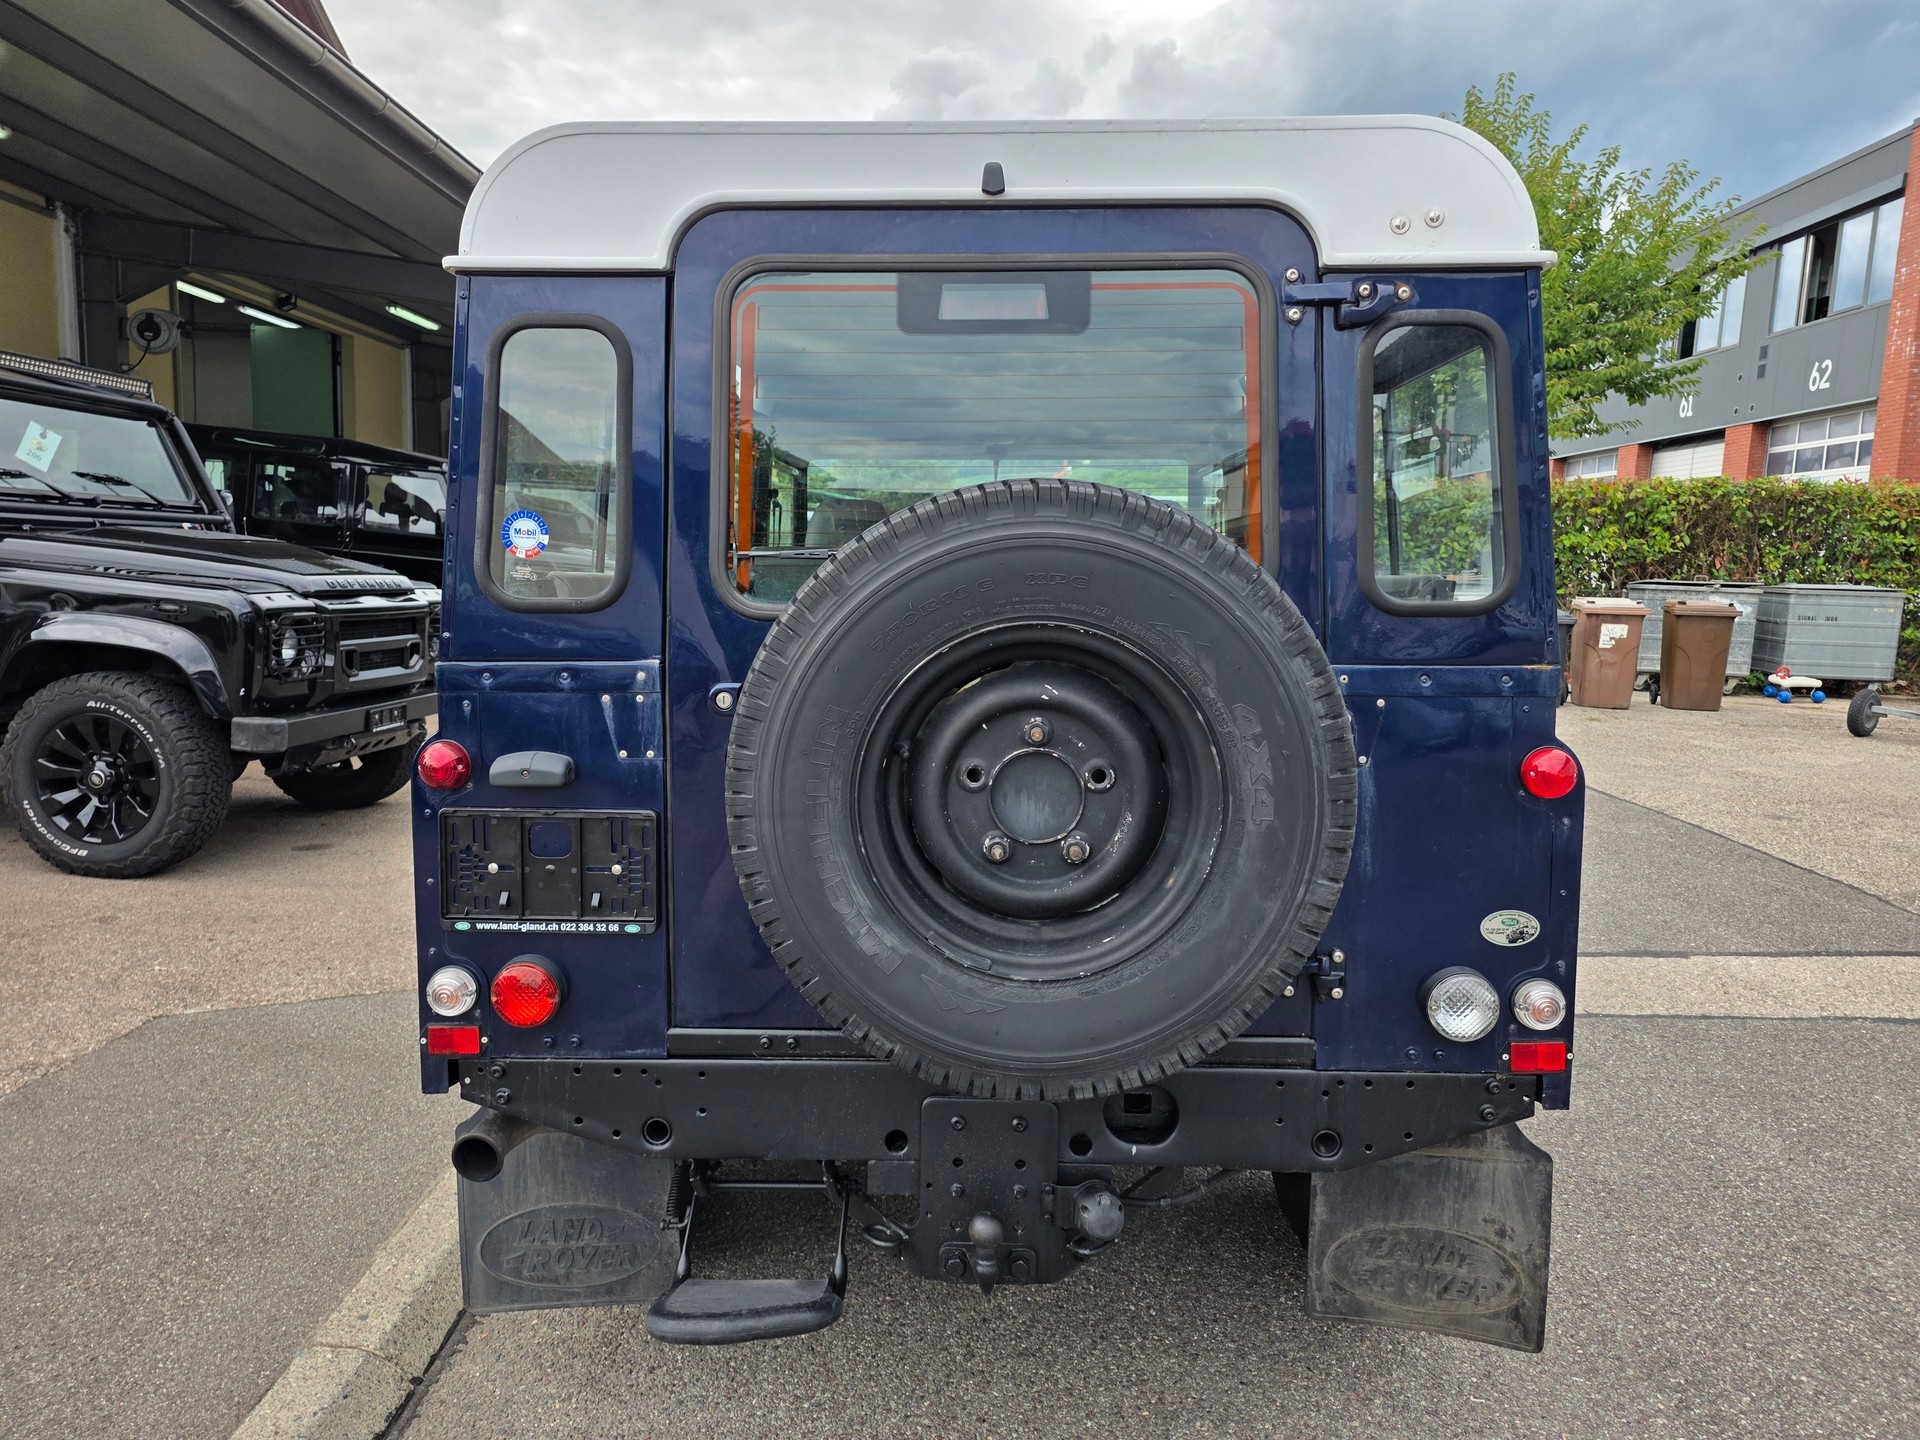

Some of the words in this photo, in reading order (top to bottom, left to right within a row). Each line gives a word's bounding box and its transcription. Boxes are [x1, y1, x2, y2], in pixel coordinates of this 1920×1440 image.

[1808, 359, 1832, 392] 62
[1679, 393, 1693, 418] 61
[514, 528, 536, 536] Mobil
[325, 579, 402, 589] DEFENDER
[87, 700, 153, 743] All-Terrain
[22, 799, 89, 857] BFGoodrich
[806, 704, 904, 975] MICHELIN
[476, 922, 559, 932] www.land-gland.ch
[578, 924, 595, 932] 364
[596, 924, 607, 932] 32
[608, 924, 619, 932] 66
[515, 1217, 604, 1246] LAND
[523, 1244, 638, 1274] ROVER
